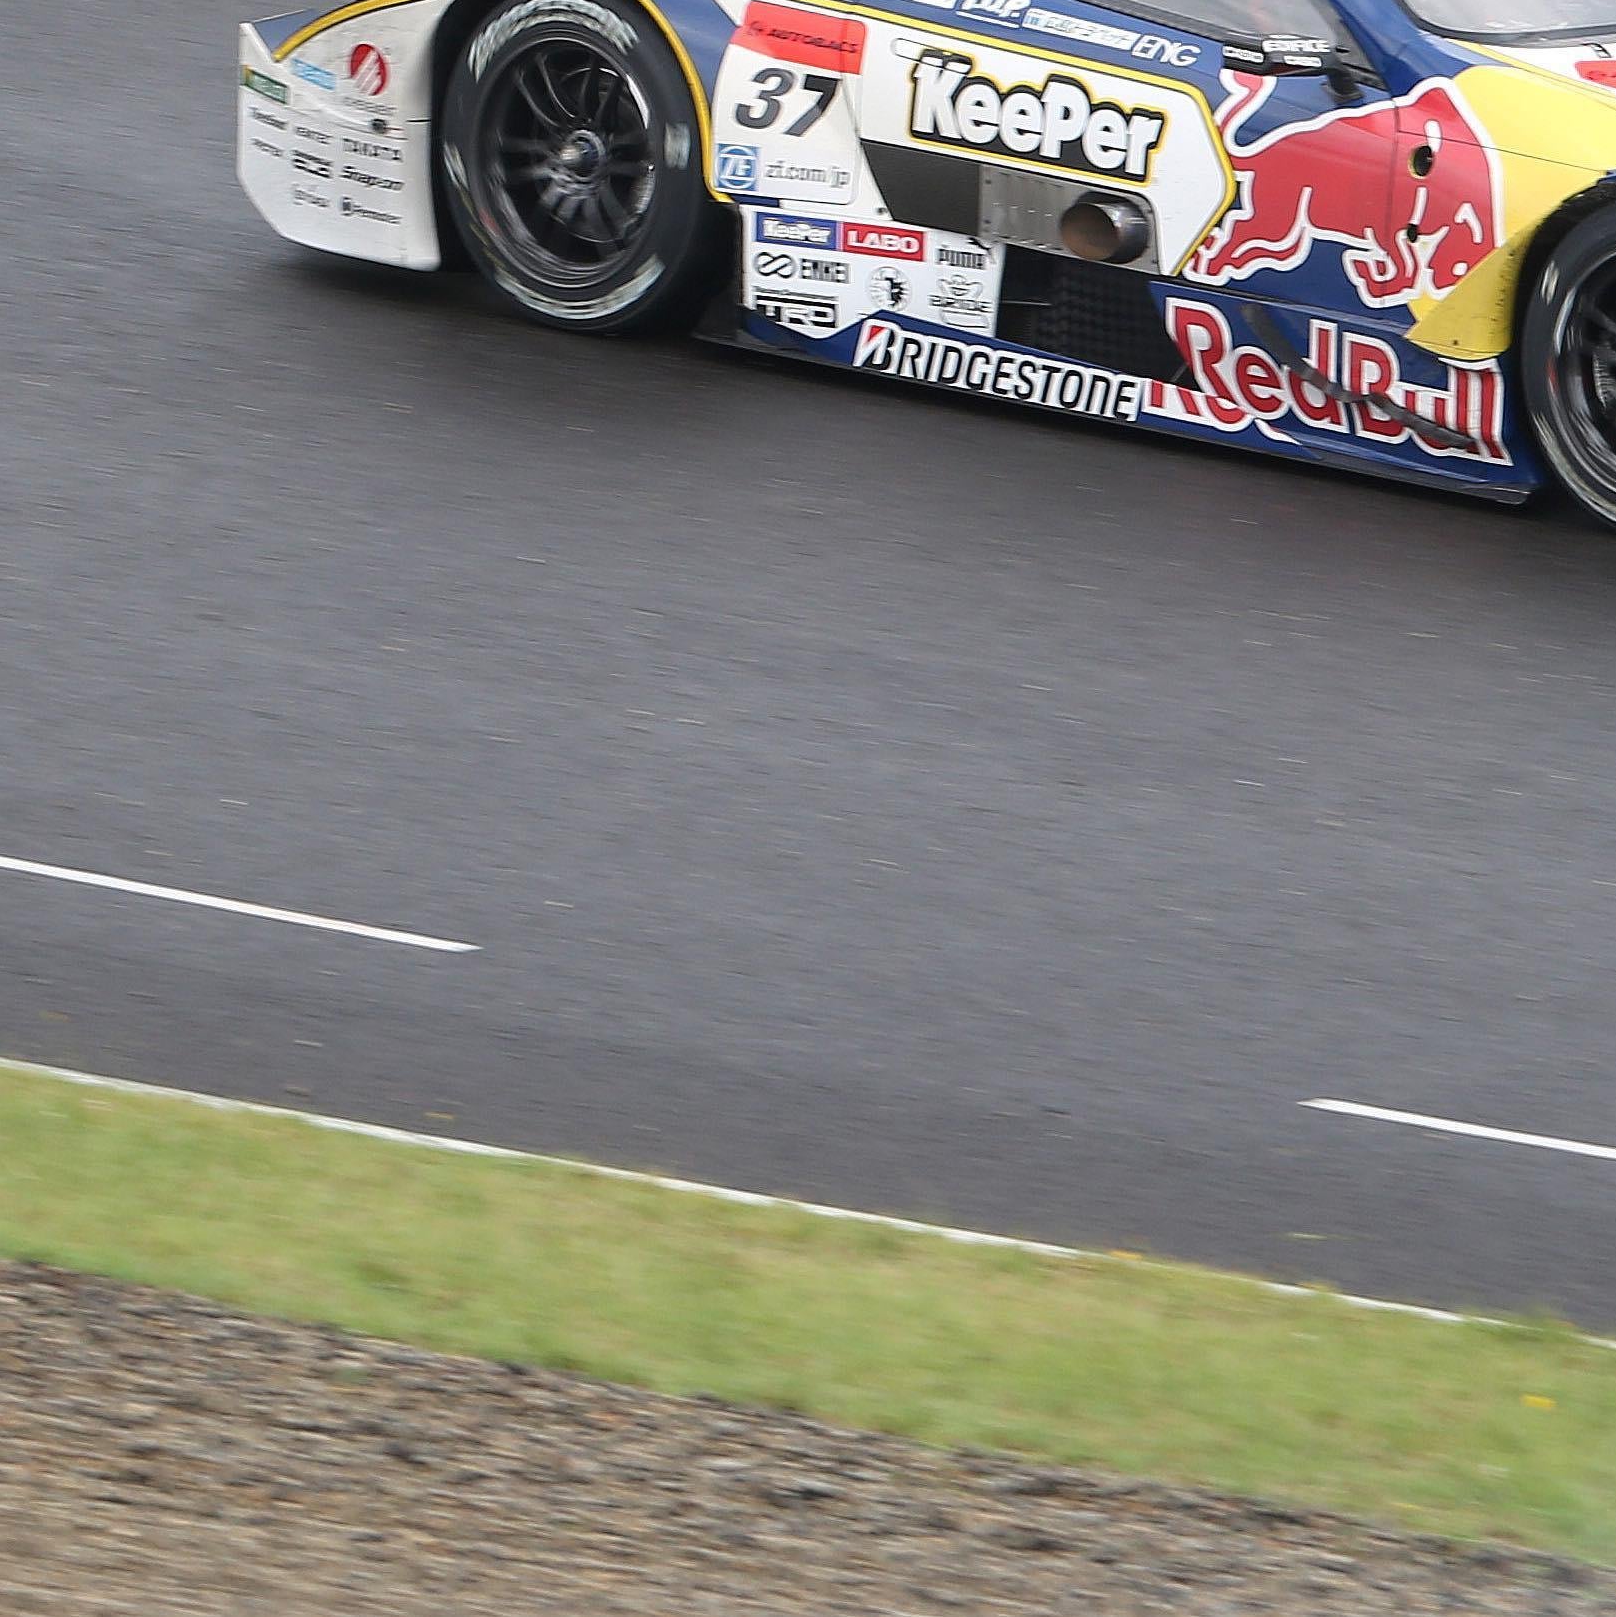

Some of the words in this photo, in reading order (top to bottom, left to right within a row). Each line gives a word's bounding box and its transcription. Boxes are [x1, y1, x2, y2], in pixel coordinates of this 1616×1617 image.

[766, 28, 858, 54] AUTOBACS
[736, 67, 843, 138] 37
[911, 49, 1167, 183] KeePer
[761, 217, 832, 243] KeePer
[846, 229, 920, 254] LABO
[754, 299, 839, 329] TRD
[853, 322, 1145, 424] BRIDGESTONE
